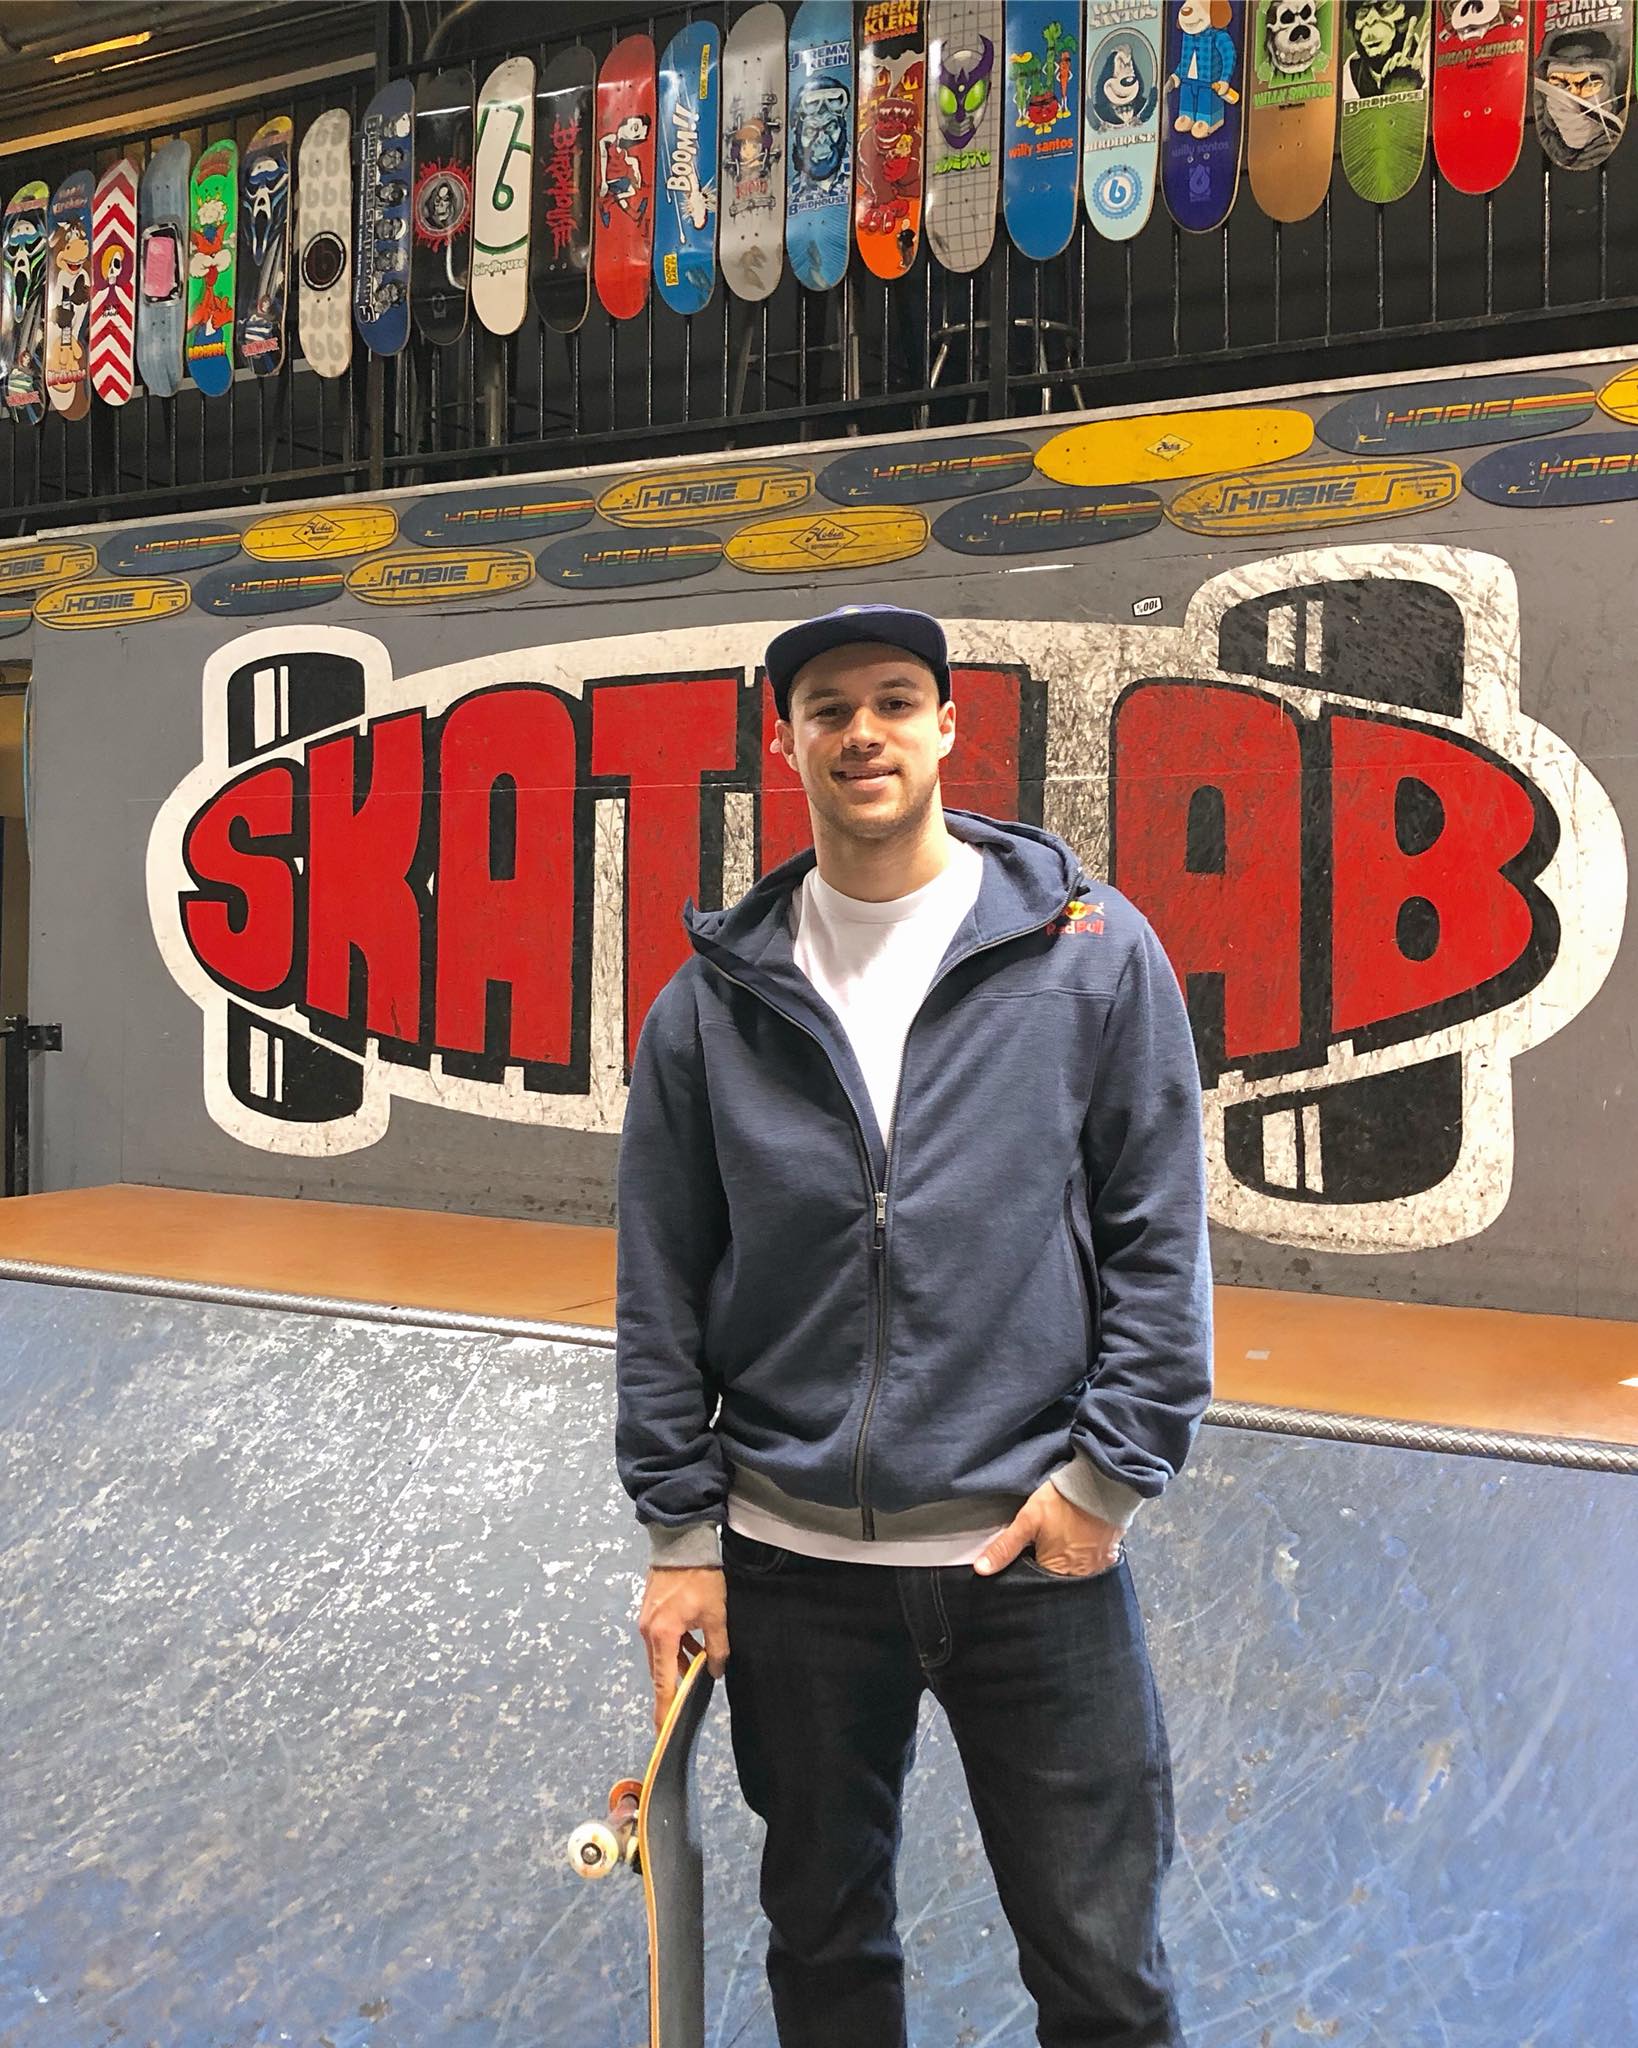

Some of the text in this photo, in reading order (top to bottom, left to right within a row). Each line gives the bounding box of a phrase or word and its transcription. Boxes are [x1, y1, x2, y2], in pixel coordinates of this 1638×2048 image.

[864, 11, 918, 36] KLEIN
[1544, 6, 1623, 32] SUMNER
[1288, 81, 1333, 102] SANTOS
[1344, 91, 1423, 115] BIRDHOUSE
[666, 102, 700, 193] BOOM!!
[1008, 143, 1032, 159] willy
[1036, 137, 1074, 153] santos
[1197, 141, 1229, 153] santos
[787, 195, 848, 216] BIRDHOUSE
[473, 258, 528, 277] birdhouse
[1385, 399, 1513, 430] HOBIE
[872, 458, 973, 482] HOBIE
[642, 482, 738, 508] HOBIE
[1228, 481, 1357, 513] HOBIE
[386, 566, 468, 586] HOBIE
[67, 593, 135, 612] HOBIE
[1076, 918, 1105, 936] Bull
